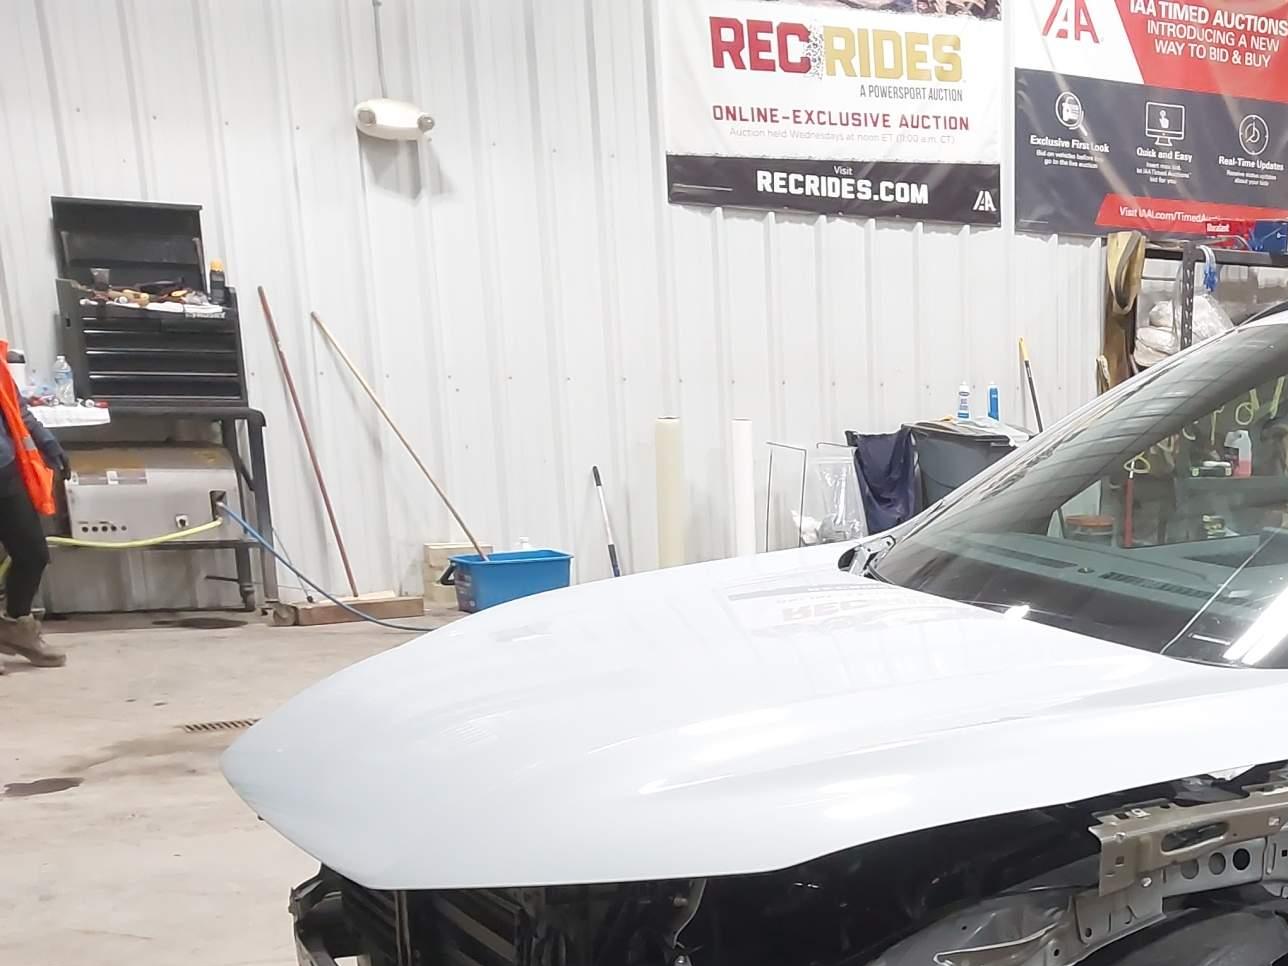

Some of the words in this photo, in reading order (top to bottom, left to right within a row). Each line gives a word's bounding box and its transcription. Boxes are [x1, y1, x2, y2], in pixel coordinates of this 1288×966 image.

[1130, 0, 1157, 17] IAA
[1158, 0, 1210, 24] TIMED
[1147, 20, 1236, 47] INTRODUCING
[1238, 33, 1248, 48] A
[1250, 35, 1280, 52] NEW
[1155, 38, 1185, 57] WAY
[1188, 43, 1207, 59] TO
[1209, 47, 1229, 63] BID
[1231, 51, 1242, 65] &
[1244, 53, 1272, 68] BUY
[860, 85, 867, 98] A
[868, 85, 926, 101] POWERSPORT
[928, 87, 963, 102] AUCTION
[712, 105, 892, 129] ONLINE-EXCLUSIVE
[899, 113, 970, 131] AUCTION
[729, 127, 765, 137] Auction
[768, 129, 787, 139] held
[1030, 135, 1070, 149] Exclusive
[1071, 139, 1090, 151] First
[1090, 143, 1110, 153] Look
[1136, 146, 1157, 158] Quick
[1158, 150, 1171, 160] and
[1174, 151, 1193, 163] Easy
[1218, 155, 1256, 168] Real-Time
[1256, 159, 1284, 171] Updates
[833, 165, 853, 176] Visit
[756, 170, 929, 205] RECRIDES.COM
[1119, 206, 1137, 217] Visit
